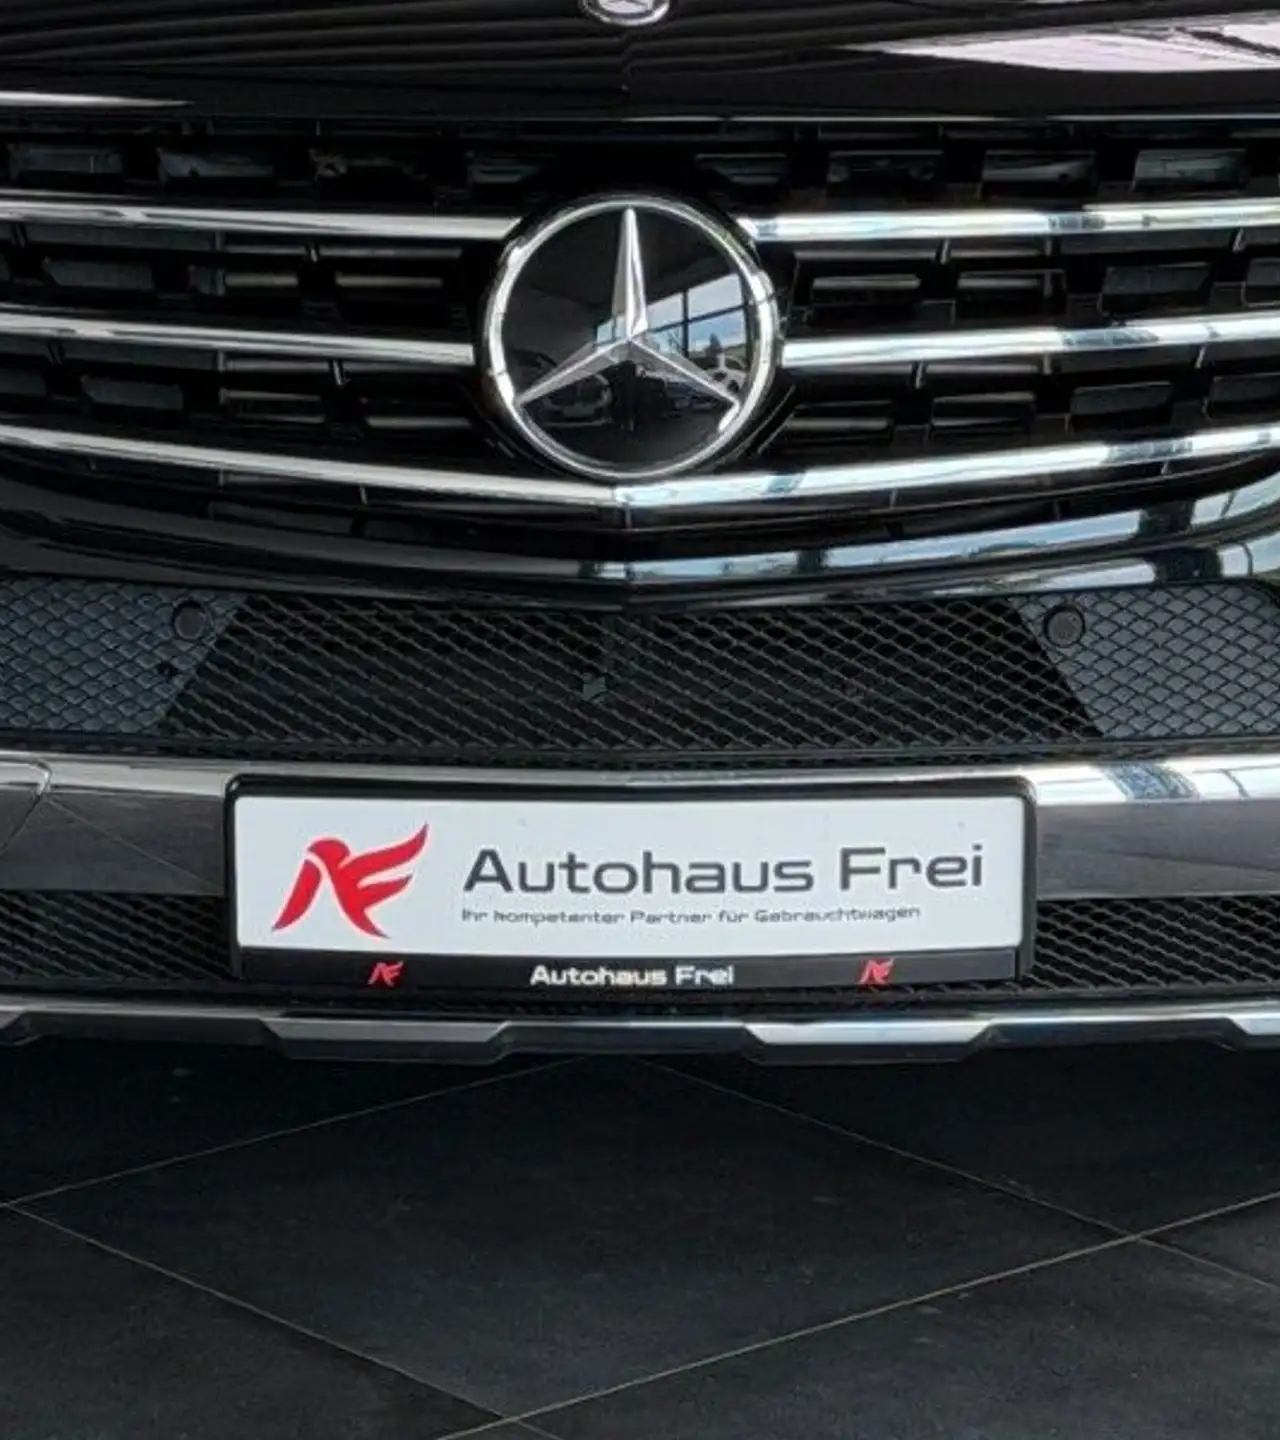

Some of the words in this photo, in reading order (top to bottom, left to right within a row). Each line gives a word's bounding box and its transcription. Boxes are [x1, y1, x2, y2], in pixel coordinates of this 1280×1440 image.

[463, 848, 814, 894] Autohaus
[839, 844, 983, 891] Frei
[461, 909, 488, 923] Ihr
[493, 909, 624, 927] kompetenter
[630, 909, 712, 925] Partner
[718, 907, 749, 924] für
[754, 905, 921, 924] Gebrauchtwagen
[529, 964, 668, 986] Autohaus
[674, 963, 735, 986] Frei
